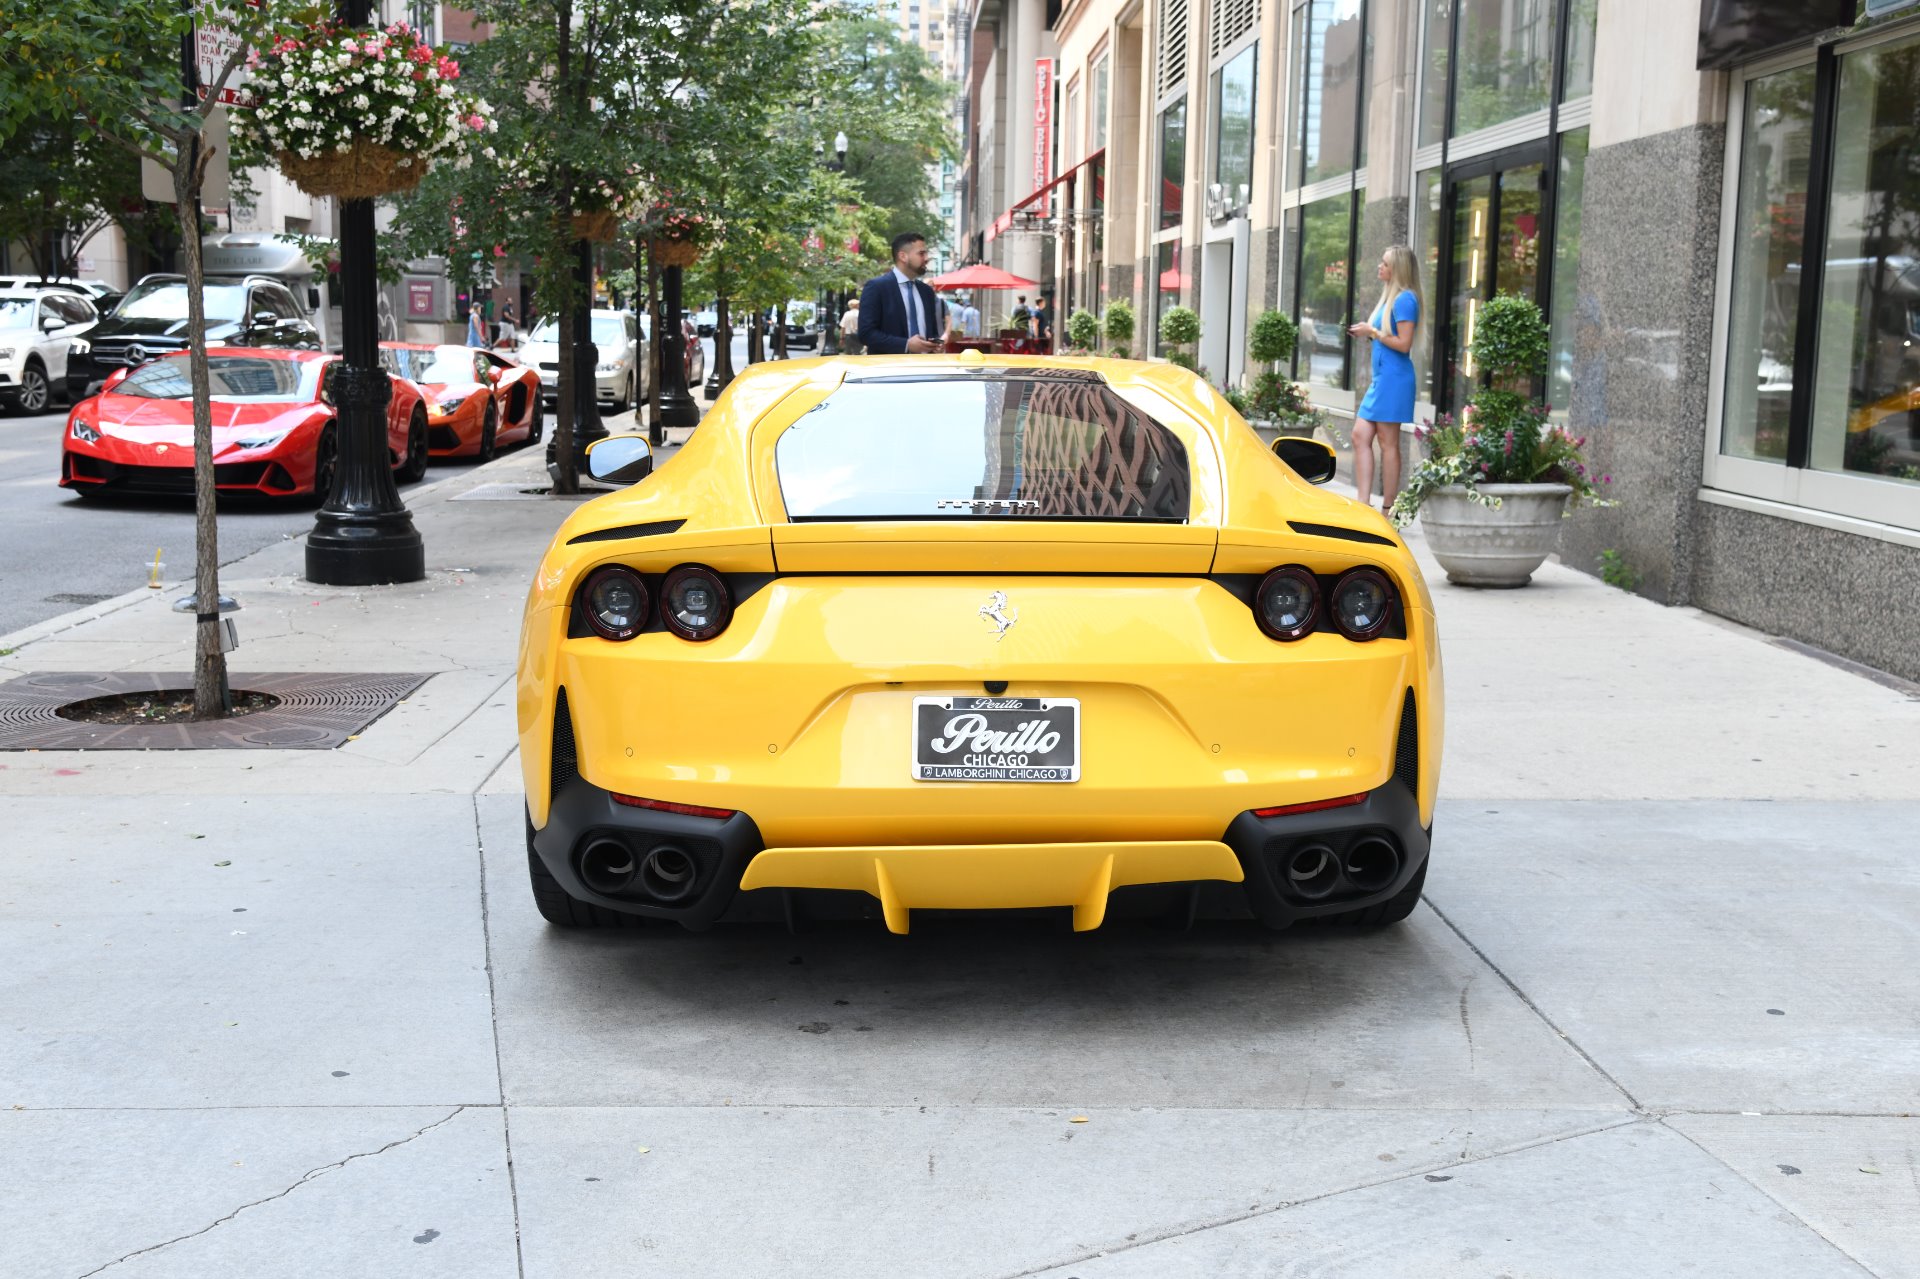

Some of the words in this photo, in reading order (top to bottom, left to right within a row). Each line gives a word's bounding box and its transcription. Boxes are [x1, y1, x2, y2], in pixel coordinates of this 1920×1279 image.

[200, 33, 217, 44] MON
[201, 44, 208, 55] 10
[210, 47, 221, 56] AM
[1037, 66, 1046, 122] EPIC
[970, 698, 1023, 710] Perillo
[930, 713, 1061, 754] Perillo
[963, 754, 1029, 767] CHICAGO
[935, 769, 1006, 779] LAMBORGHINI
[1009, 769, 1057, 779] CHICAGO
